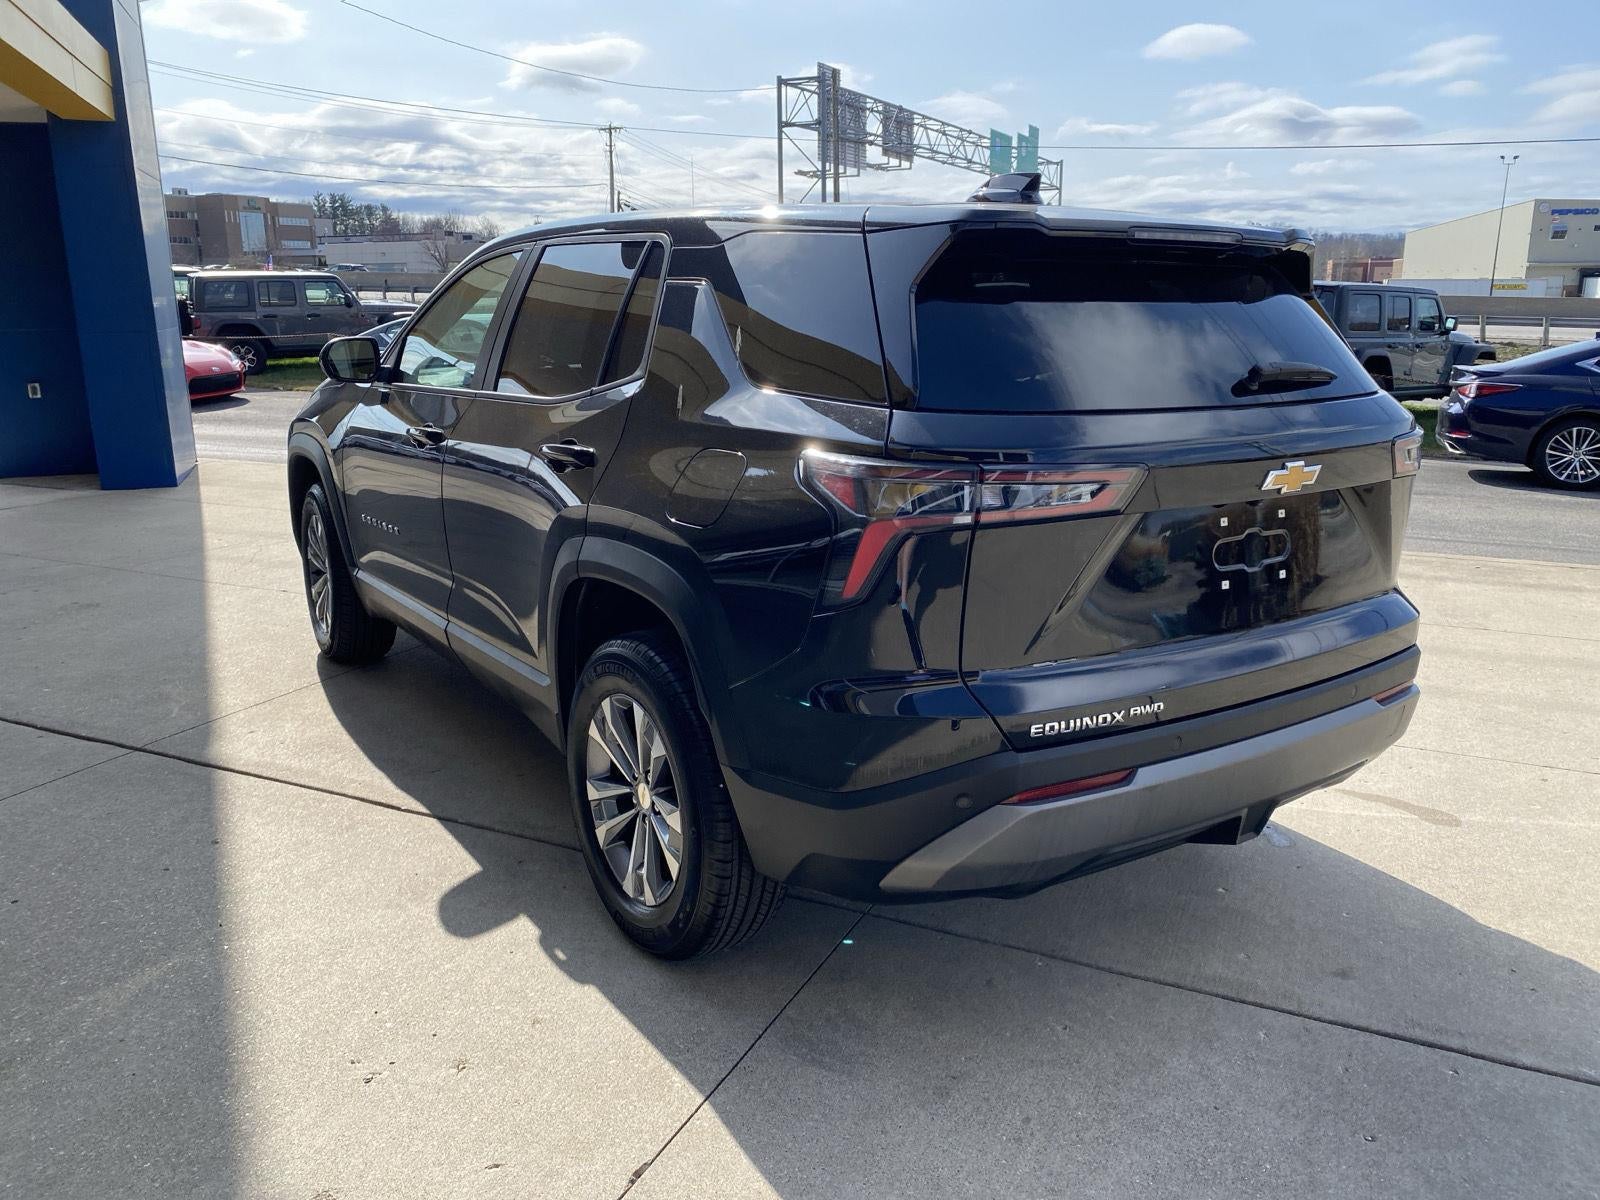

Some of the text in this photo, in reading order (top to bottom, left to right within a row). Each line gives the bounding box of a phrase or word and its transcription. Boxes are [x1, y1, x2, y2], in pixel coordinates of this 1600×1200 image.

[596, 663, 633, 680] MICHELIN
[1030, 702, 1165, 738] EQUINOX AWD
